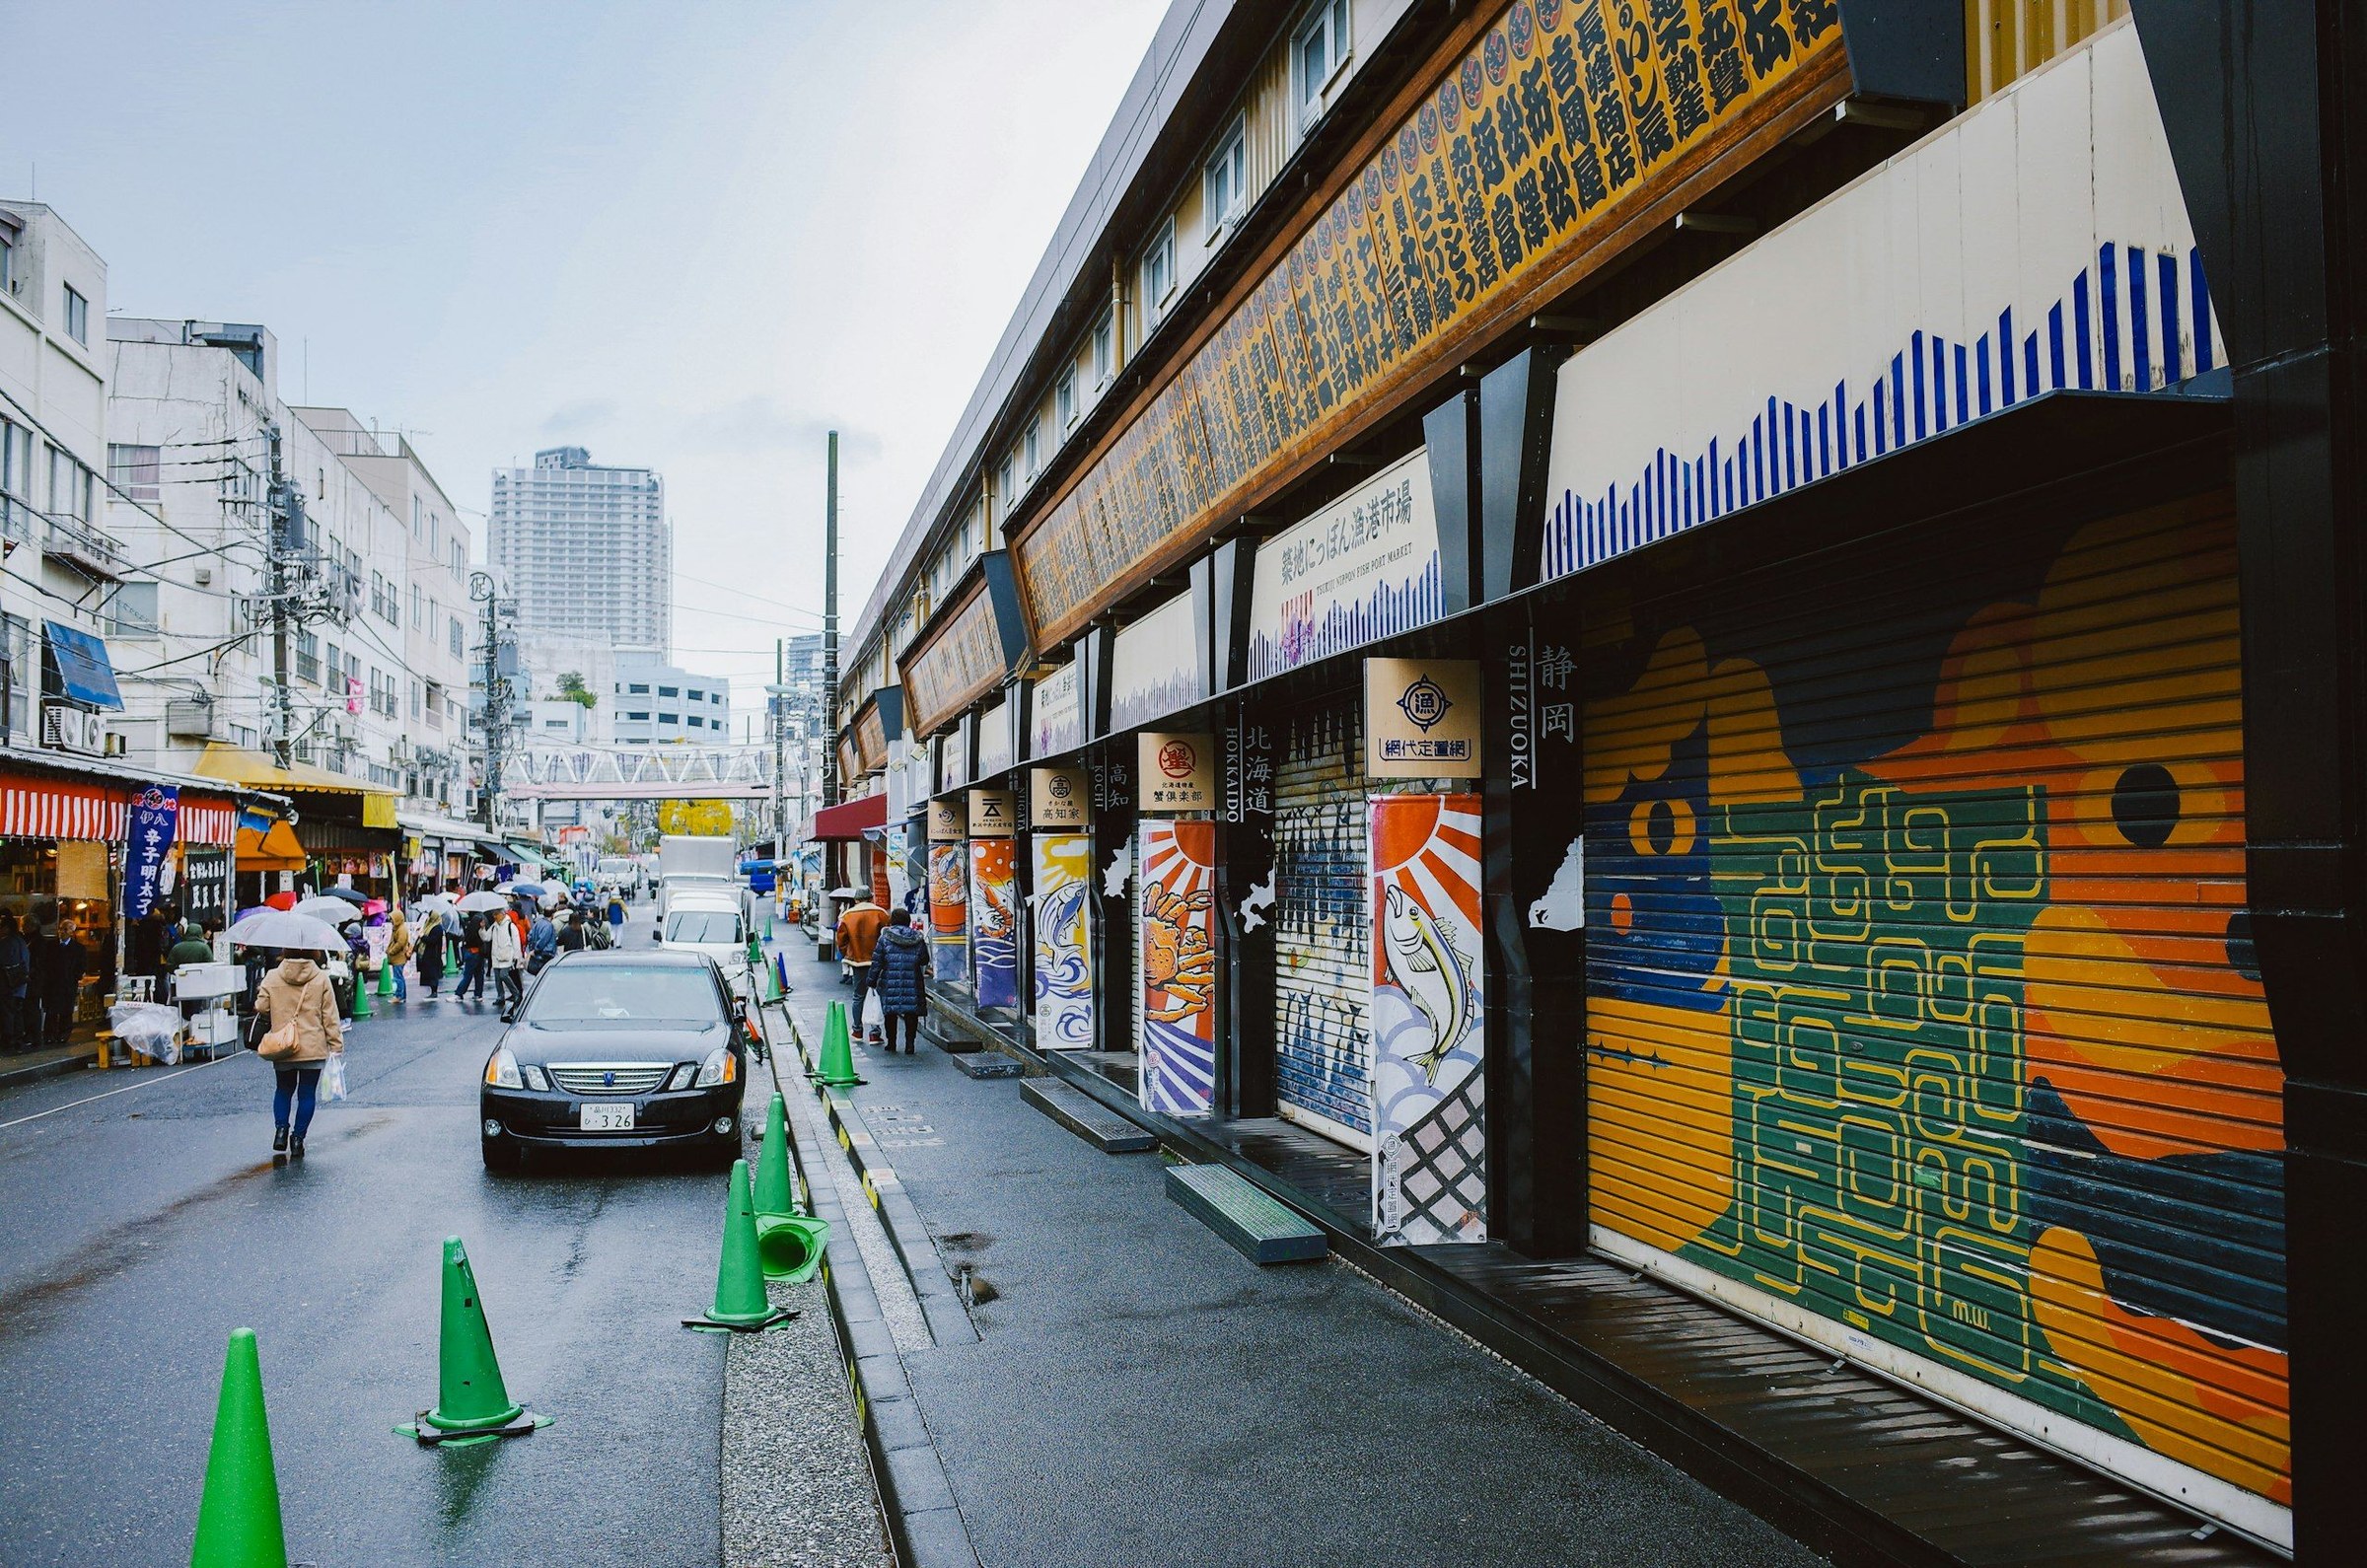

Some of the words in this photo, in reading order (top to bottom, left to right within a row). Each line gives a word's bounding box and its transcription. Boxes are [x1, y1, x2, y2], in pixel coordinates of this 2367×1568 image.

[1613, 0, 1674, 176] のいし辰
[1699, 0, 1749, 115] 丸豊
[1547, 34, 1608, 214] 吉岡屋
[1282, 478, 1412, 586] 築地にっぽん漁港市場
[1336, 569, 1355, 588] NIPPON
[1357, 562, 1369, 578] FISH
[1371, 554, 1385, 572] PORT
[1388, 542, 1412, 563] MARKET
[1509, 645, 1529, 790] SHIZUOKA
[1536, 645, 1578, 744] 静岡
[1095, 765, 1104, 808] KOCHI
[1109, 763, 1129, 808] 高知
[1226, 728, 1239, 822] HOKKAIDO
[1245, 726, 1274, 815] 北海道
[1385, 740, 1466, 757] 網代定置網
[1043, 808, 1080, 820] 高知家
[136, 828, 162, 915] 辛子明太子
